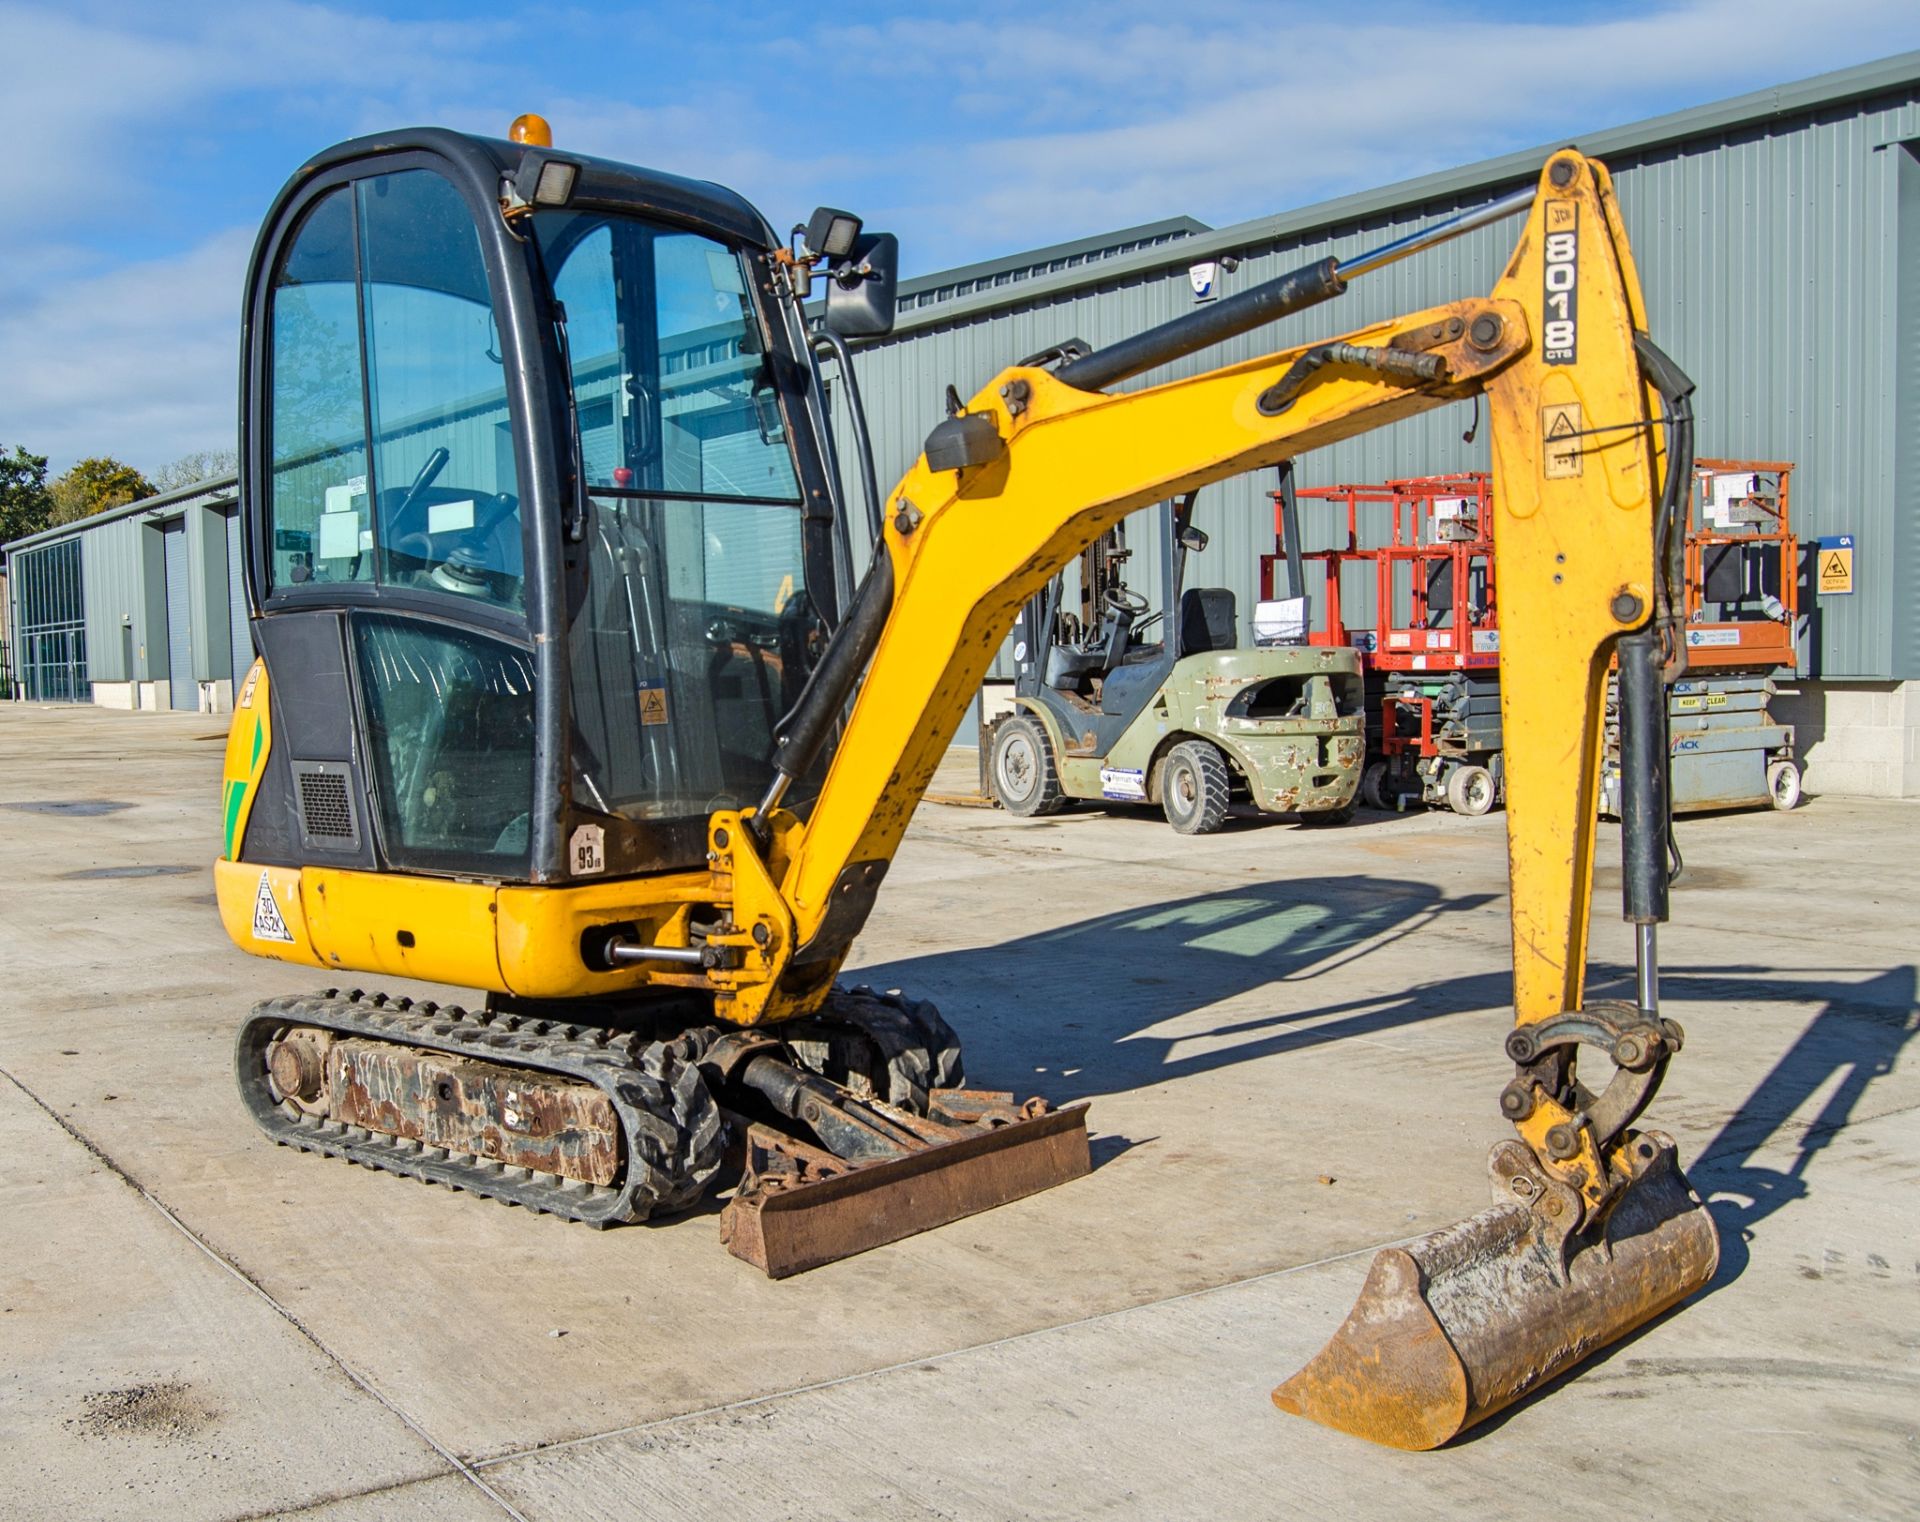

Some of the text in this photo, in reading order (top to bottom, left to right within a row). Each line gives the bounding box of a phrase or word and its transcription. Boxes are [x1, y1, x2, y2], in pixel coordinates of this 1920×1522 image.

[1545, 234, 1575, 349] 8018
[1546, 349, 1572, 359] CTS
[1706, 696, 1726, 705] CLEAR
[585, 832, 592, 841] L
[578, 846, 594, 870] 93
